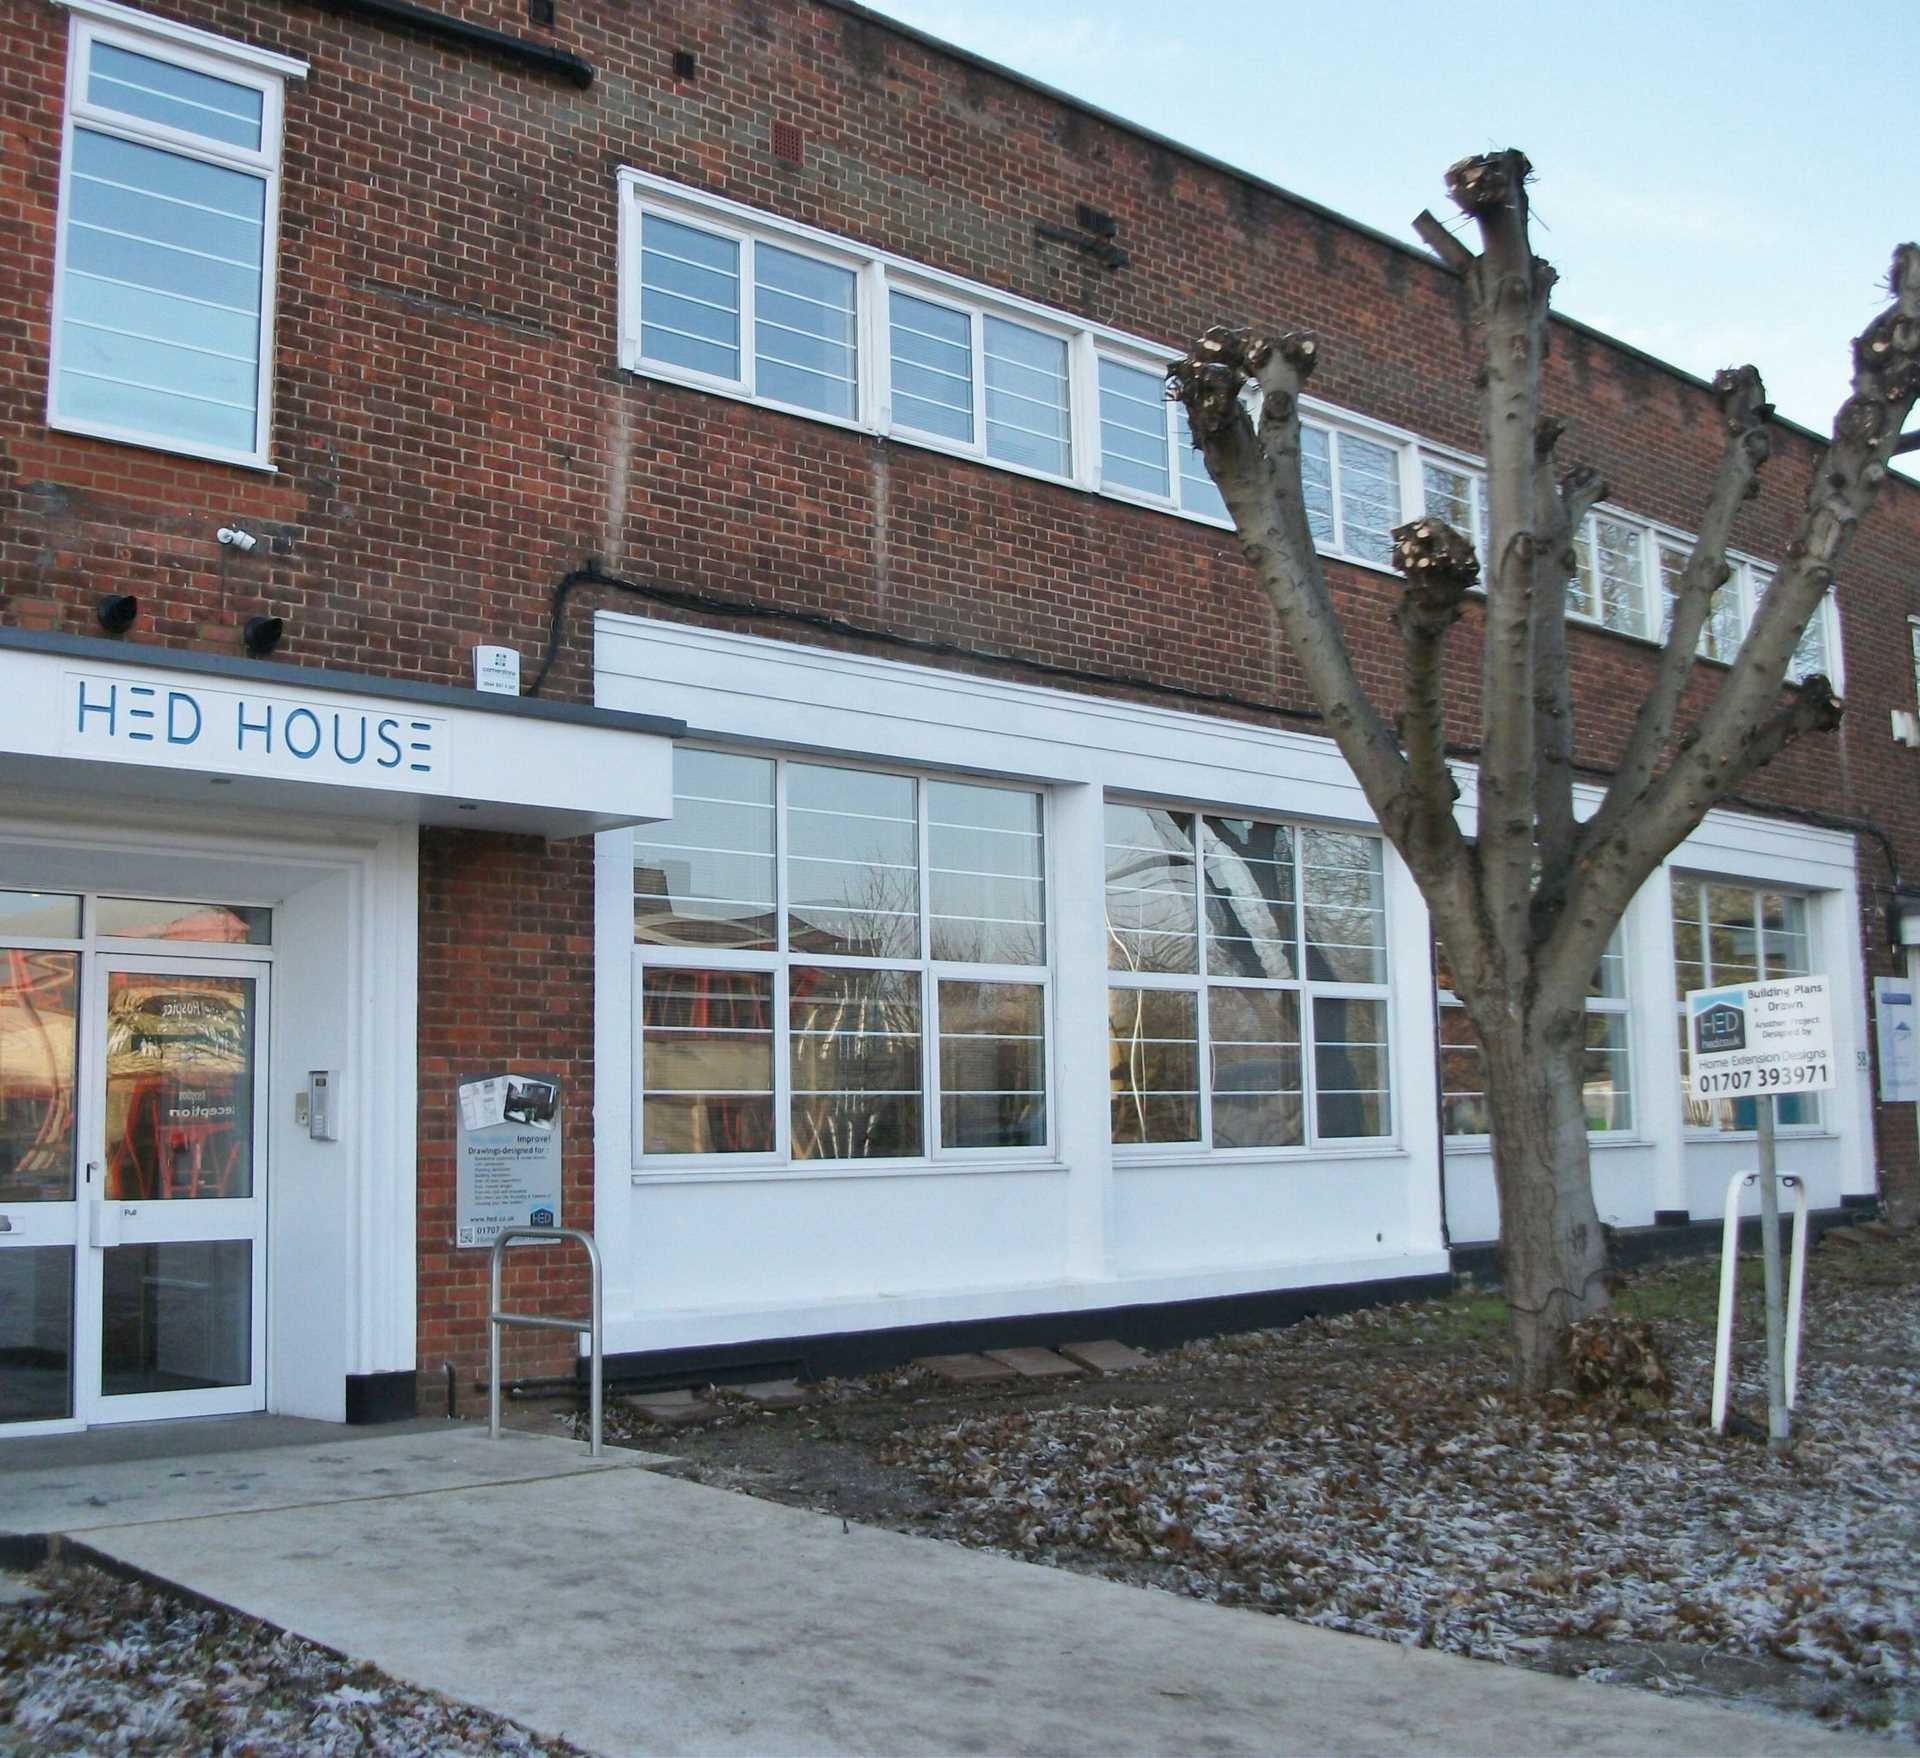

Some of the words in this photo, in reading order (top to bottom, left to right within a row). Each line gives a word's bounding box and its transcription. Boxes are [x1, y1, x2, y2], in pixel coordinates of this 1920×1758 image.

[78, 680, 203, 746] HED
[237, 700, 432, 772] HOUSE
[1747, 986, 1790, 1000] Building
[1794, 984, 1824, 995] Plans
[1767, 1001, 1804, 1011] Drawn
[1700, 1011, 1739, 1035] HED
[1755, 1020, 1786, 1029] Another
[1699, 1058, 1729, 1069] Home
[1731, 1053, 1780, 1066] Extension
[1782, 1049, 1827, 1063] Designs
[1699, 1070, 1752, 1093] 01707
[1757, 1064, 1828, 1088] 393971
[476, 1225, 500, 1235] 01707
